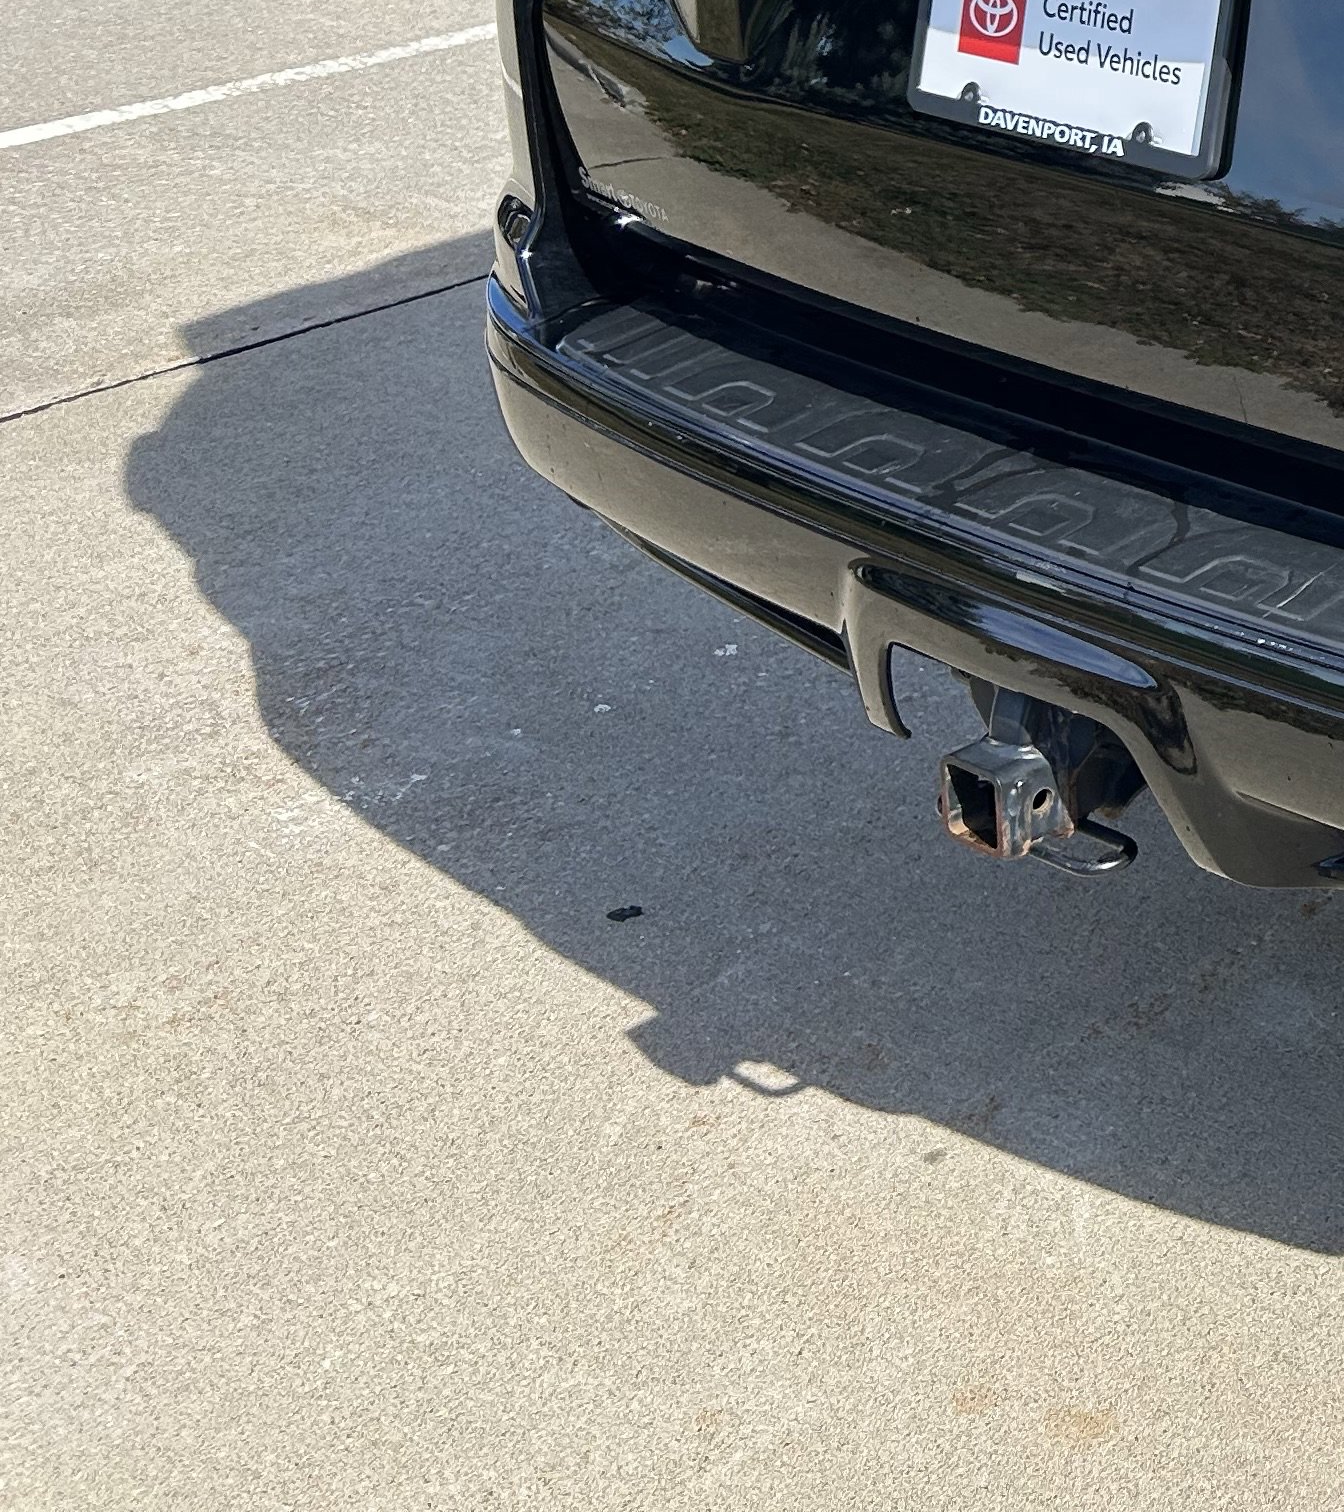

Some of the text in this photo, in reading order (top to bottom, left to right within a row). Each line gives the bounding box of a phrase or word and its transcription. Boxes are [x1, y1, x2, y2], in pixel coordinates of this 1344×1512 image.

[1039, 31, 1182, 85] Used Vehicles
[978, 106, 1125, 157] DAVENPORT, IA
